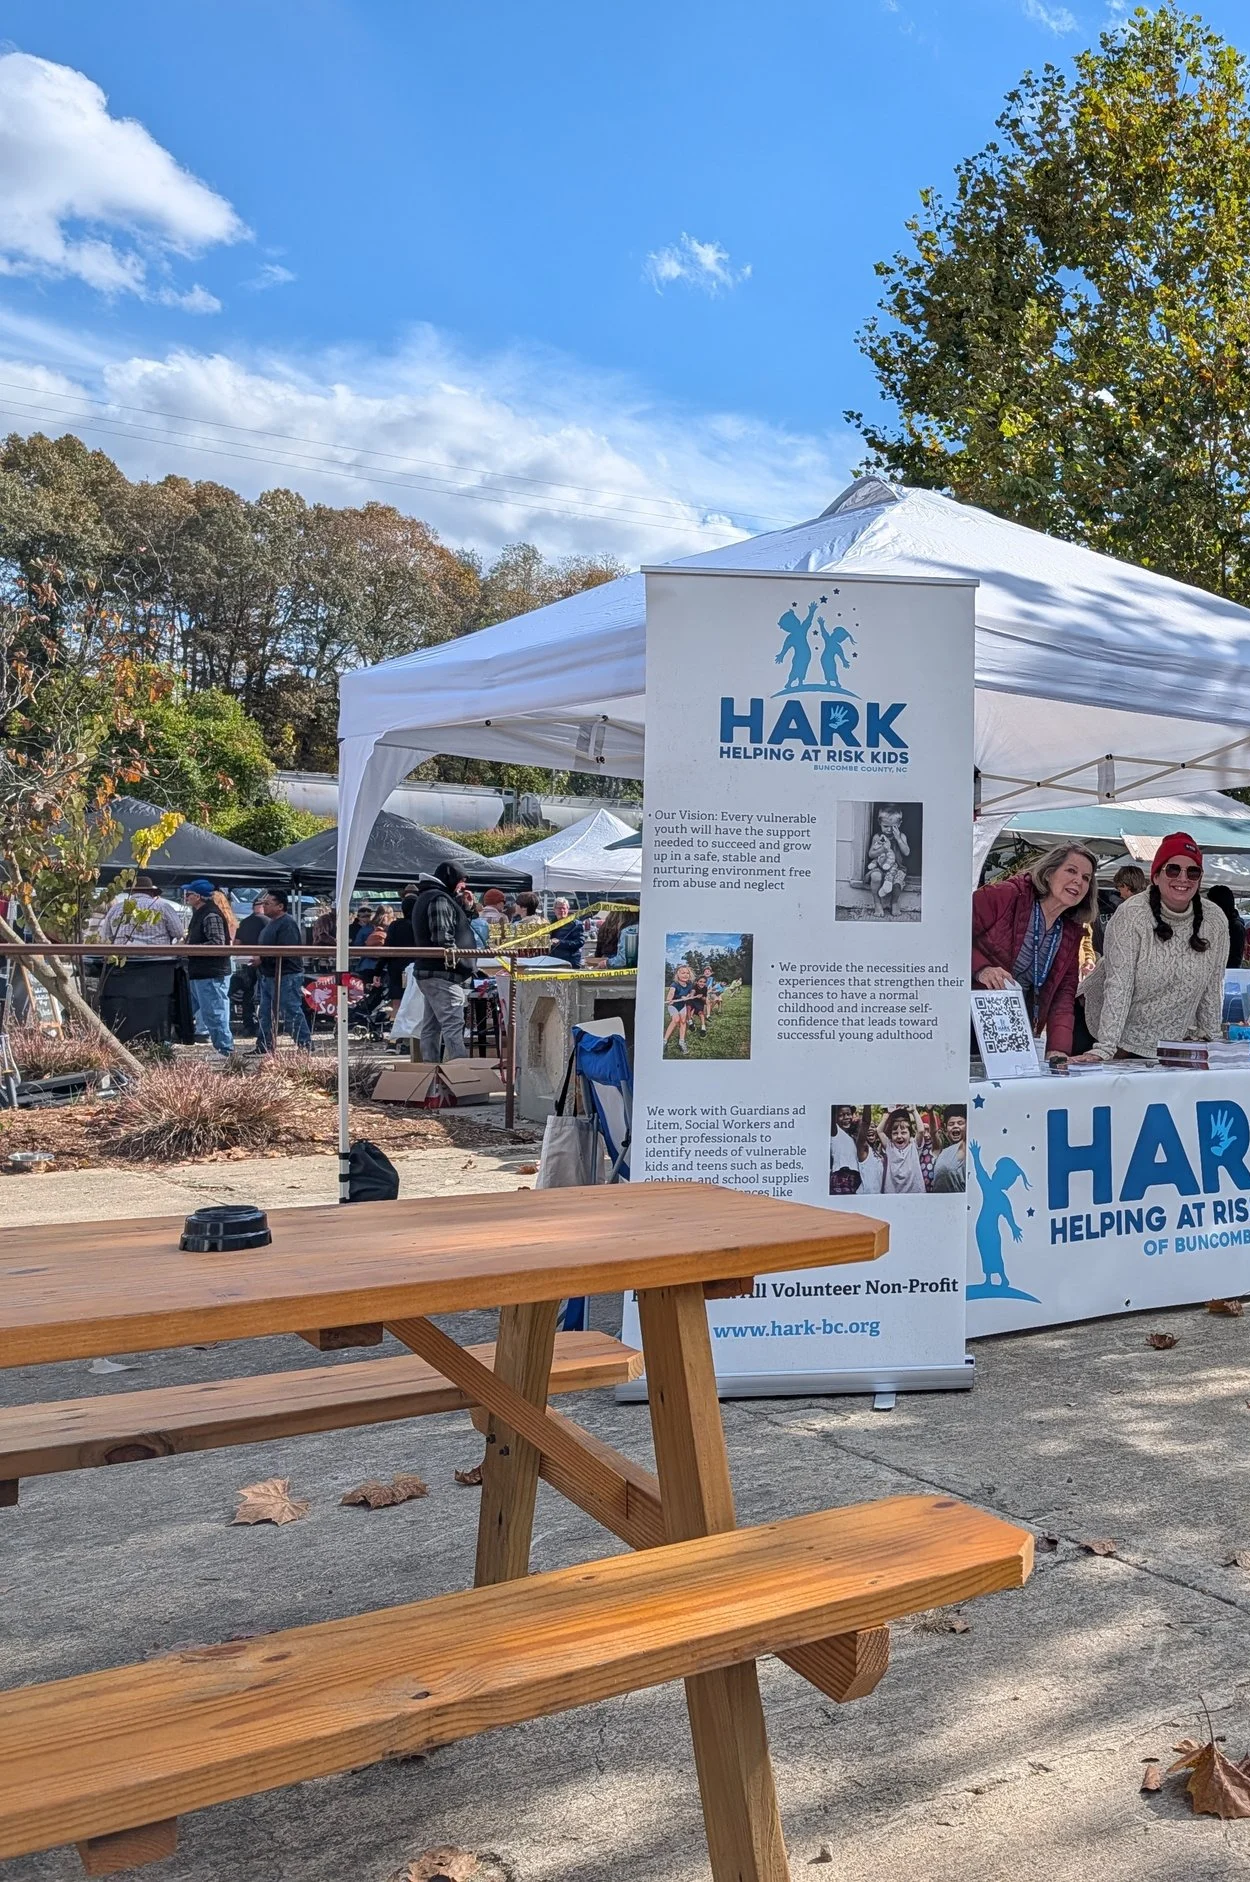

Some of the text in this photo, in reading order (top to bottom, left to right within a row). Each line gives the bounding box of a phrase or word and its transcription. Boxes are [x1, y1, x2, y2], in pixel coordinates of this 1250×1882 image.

[719, 697, 909, 749] HARK
[720, 746, 909, 764] HELPING AT RISK KIDS
[655, 810, 816, 824] Our Vision: Every vulnerable
[654, 824, 810, 839] youth will have the support
[654, 837, 811, 852] needed to succeed and grow
[654, 853, 667, 863] up
[670, 852, 681, 860] in
[694, 851, 719, 862] safe,
[722, 852, 756, 862] stable
[759, 854, 780, 863] and
[654, 865, 811, 877] nurturing environment free
[653, 878, 784, 892] from abuse and neglect
[779, 962, 948, 974] We provide the necessities and
[779, 976, 964, 989] experiences that strengthen their
[778, 989, 823, 999] chances
[826, 991, 838, 999] to
[841, 990, 867, 999] have
[879, 990, 918, 999] normal
[778, 1003, 932, 1014] childhood and increase self-
[778, 1016, 938, 1026] confidence that leads toward
[777, 1030, 933, 1042] successful young adulthood
[647, 1105, 806, 1116] We work with Guardians ad
[647, 1119, 795, 1130] Litem, Social Workers and
[646, 1133, 771, 1146] other professionals to
[645, 1146, 806, 1159] identify needs of vulnerable
[645, 1161, 668, 1171] kids
[672, 1161, 693, 1171] and
[697, 1162, 727, 1170] teens
[730, 1160, 757, 1170] such
[776, 1159, 803, 1170] beds,
[698, 1174, 719, 1185] and
[722, 1174, 759, 1184] school
[762, 1173, 809, 1185] supplies
[773, 1187, 792, 1197] like
[1049, 1205, 1168, 1246] HELPING
[1177, 1202, 1205, 1229] AT
[1144, 1239, 1168, 1256] OF
[771, 1282, 861, 1297] Volunteer
[865, 1278, 958, 1294] Non-Profit
[713, 1319, 880, 1338] www.hark-bc.org
